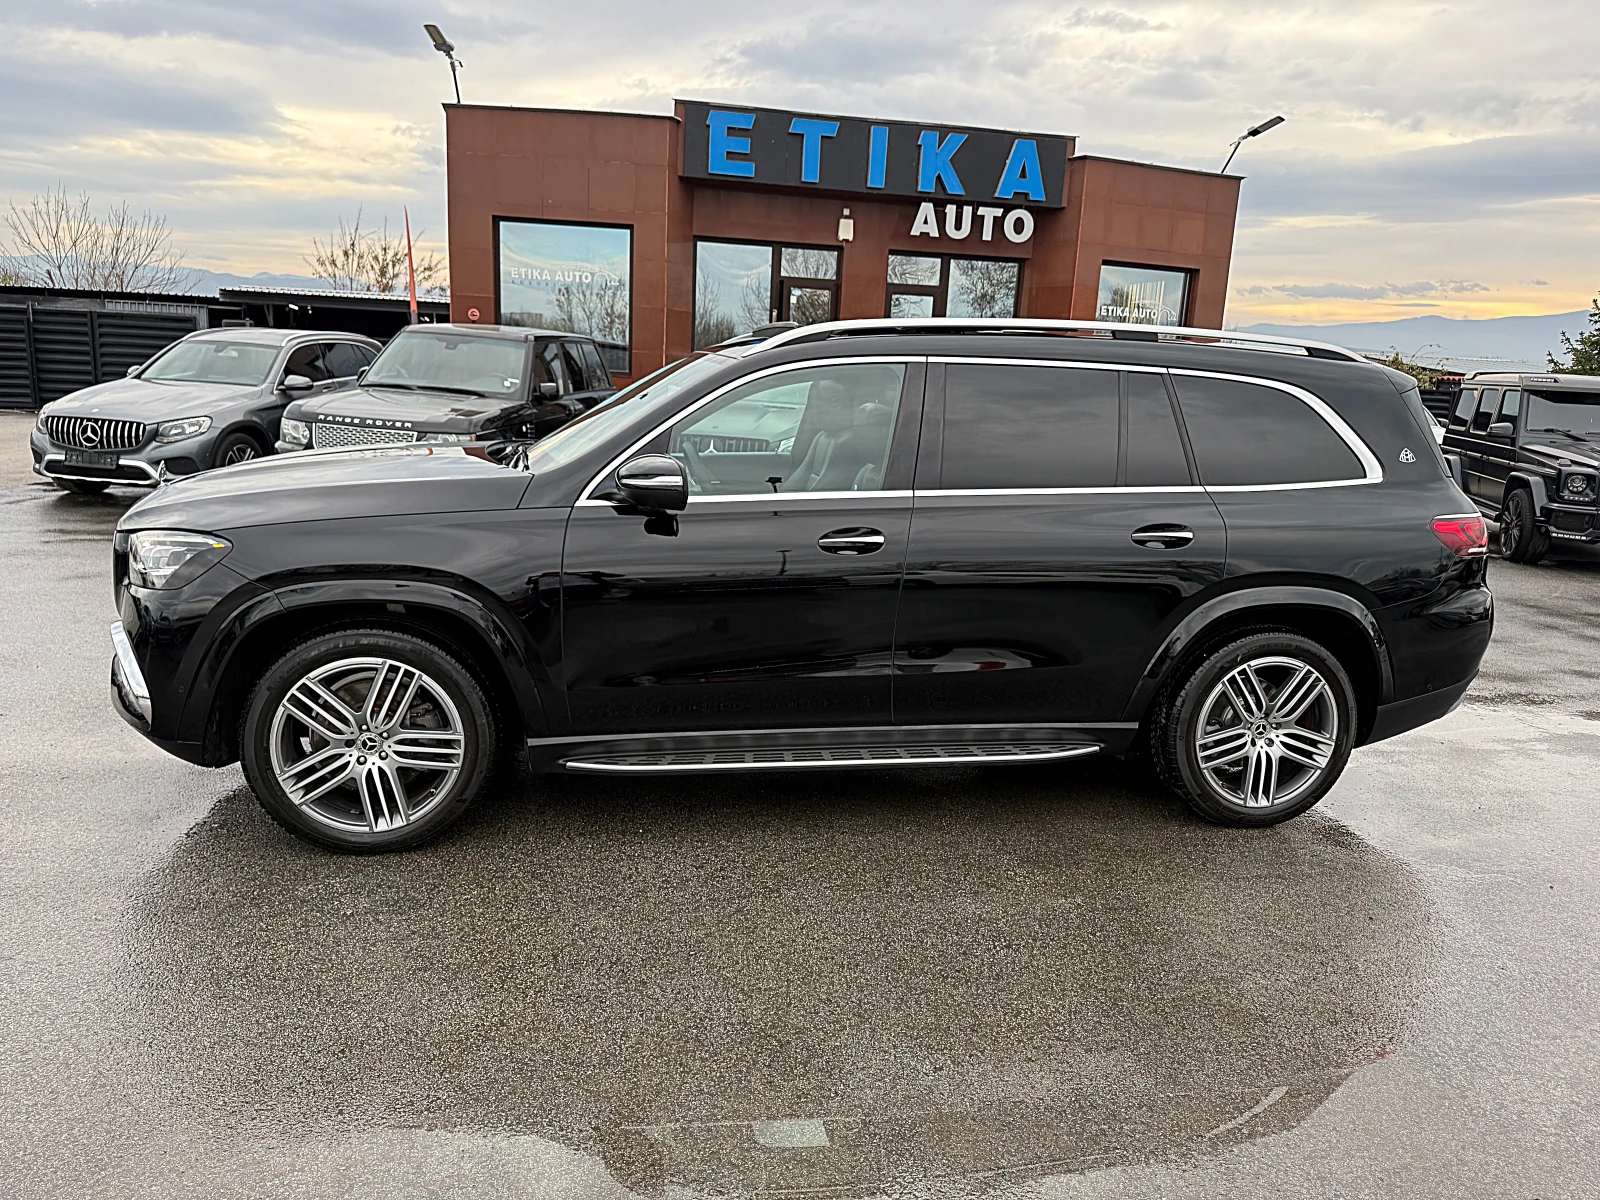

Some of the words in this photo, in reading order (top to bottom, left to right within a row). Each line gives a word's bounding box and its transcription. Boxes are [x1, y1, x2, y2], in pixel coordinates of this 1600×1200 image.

[706, 110, 1046, 201] ETIKA
[910, 202, 1035, 243] AUTO
[511, 267, 551, 281] ETIKA
[555, 270, 592, 283] AUTO
[1101, 306, 1130, 317] ETIKA
[1132, 308, 1158, 319] AUTO
[318, 414, 360, 424] RANGE
[365, 419, 412, 428] ROVER
